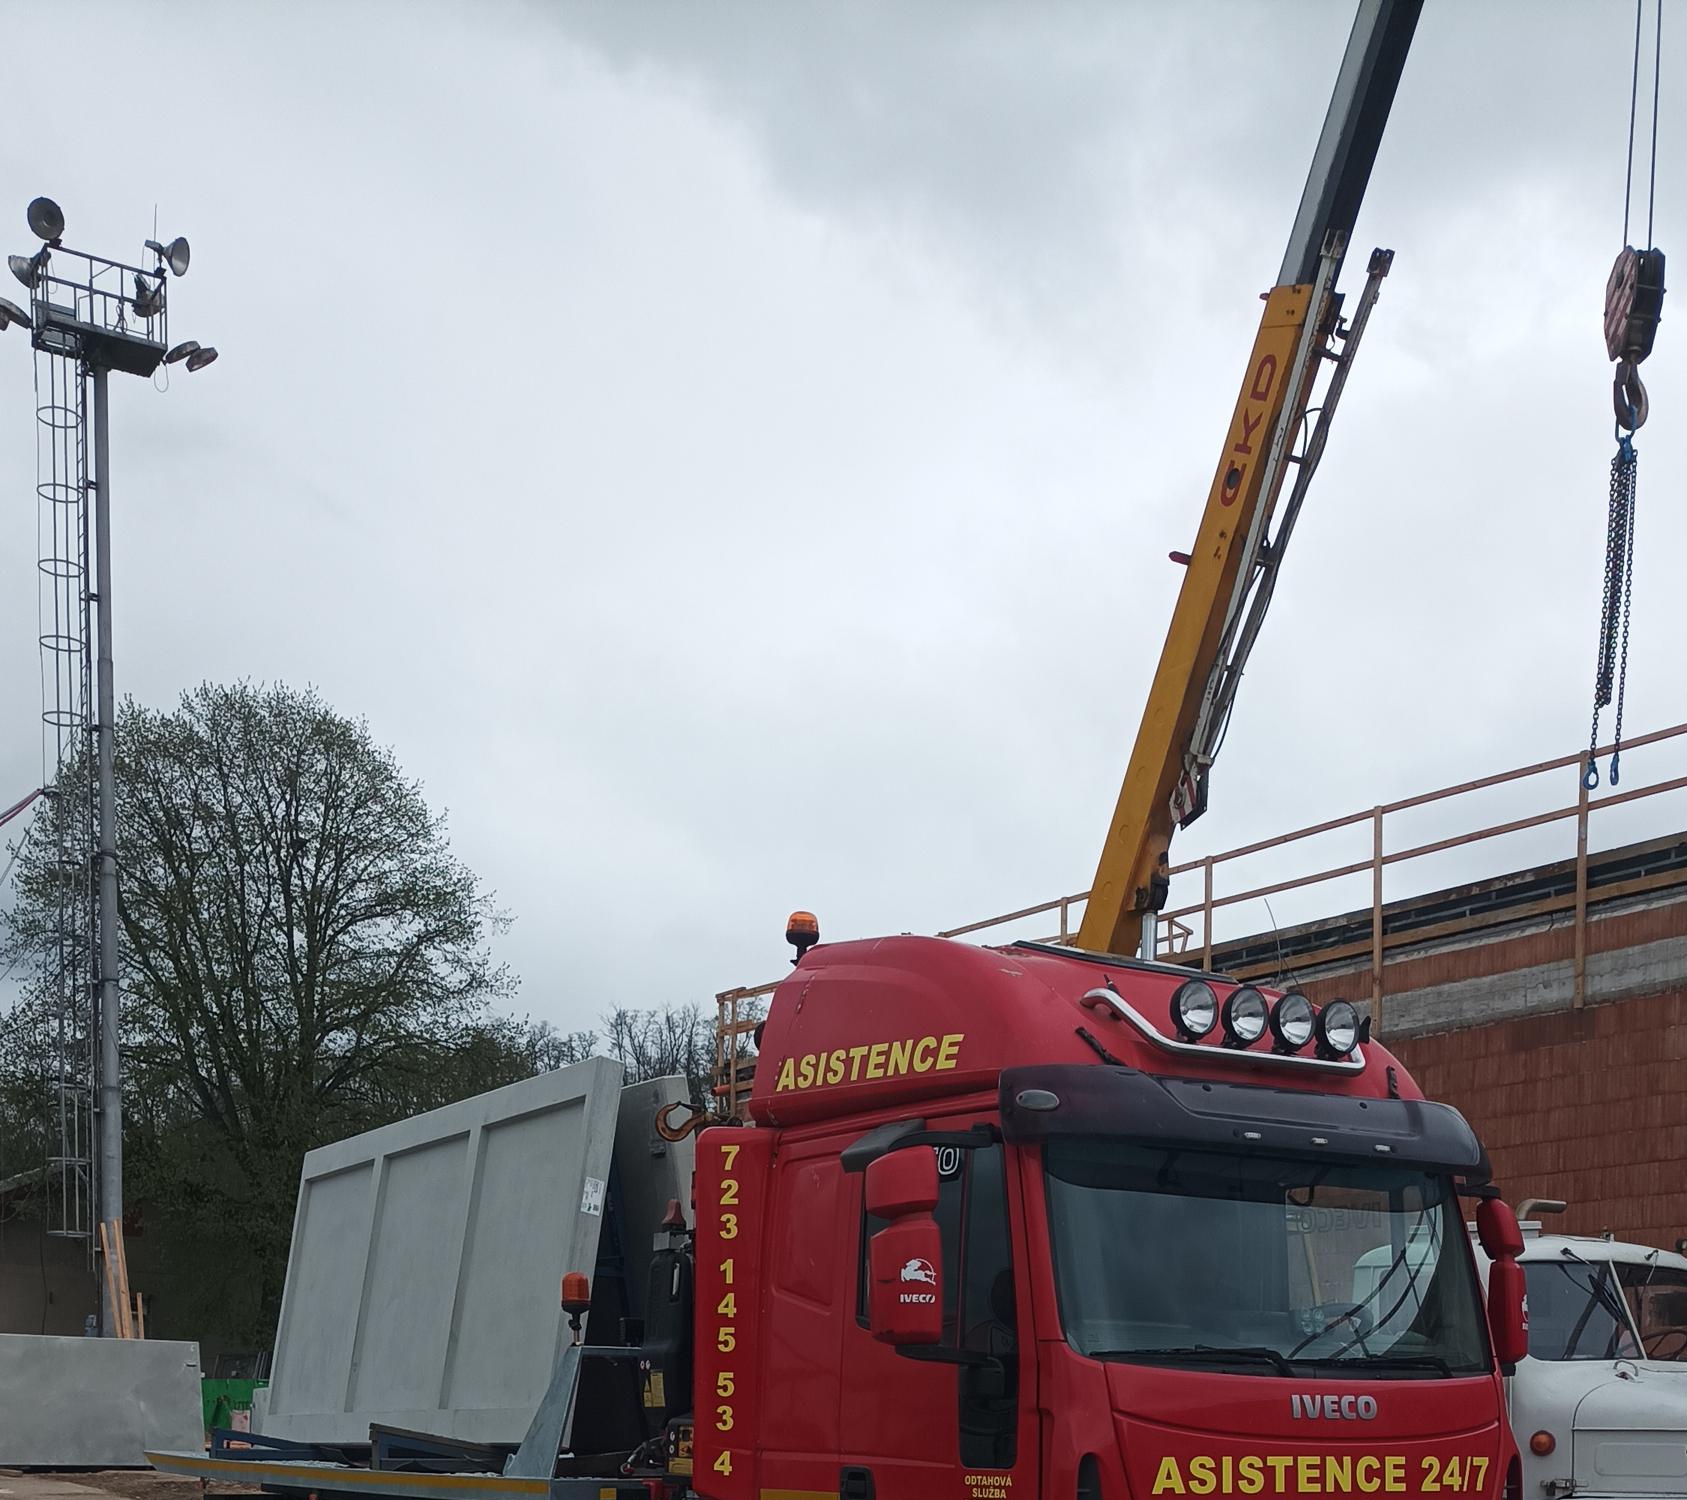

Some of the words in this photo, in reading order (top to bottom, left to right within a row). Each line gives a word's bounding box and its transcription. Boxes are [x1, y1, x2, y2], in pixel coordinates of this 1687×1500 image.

[776, 1033, 965, 1092] ASISTENCE
[899, 1293, 936, 1304] IVECO
[1291, 1393, 1378, 1421] IVECO
[964, 1474, 1012, 1487] ODTAHOVÁ
[1151, 1455, 1408, 1496] ASISTENCE
[1420, 1455, 1490, 1493] 24/7
[972, 1487, 1007, 1499] SLUŽBA
